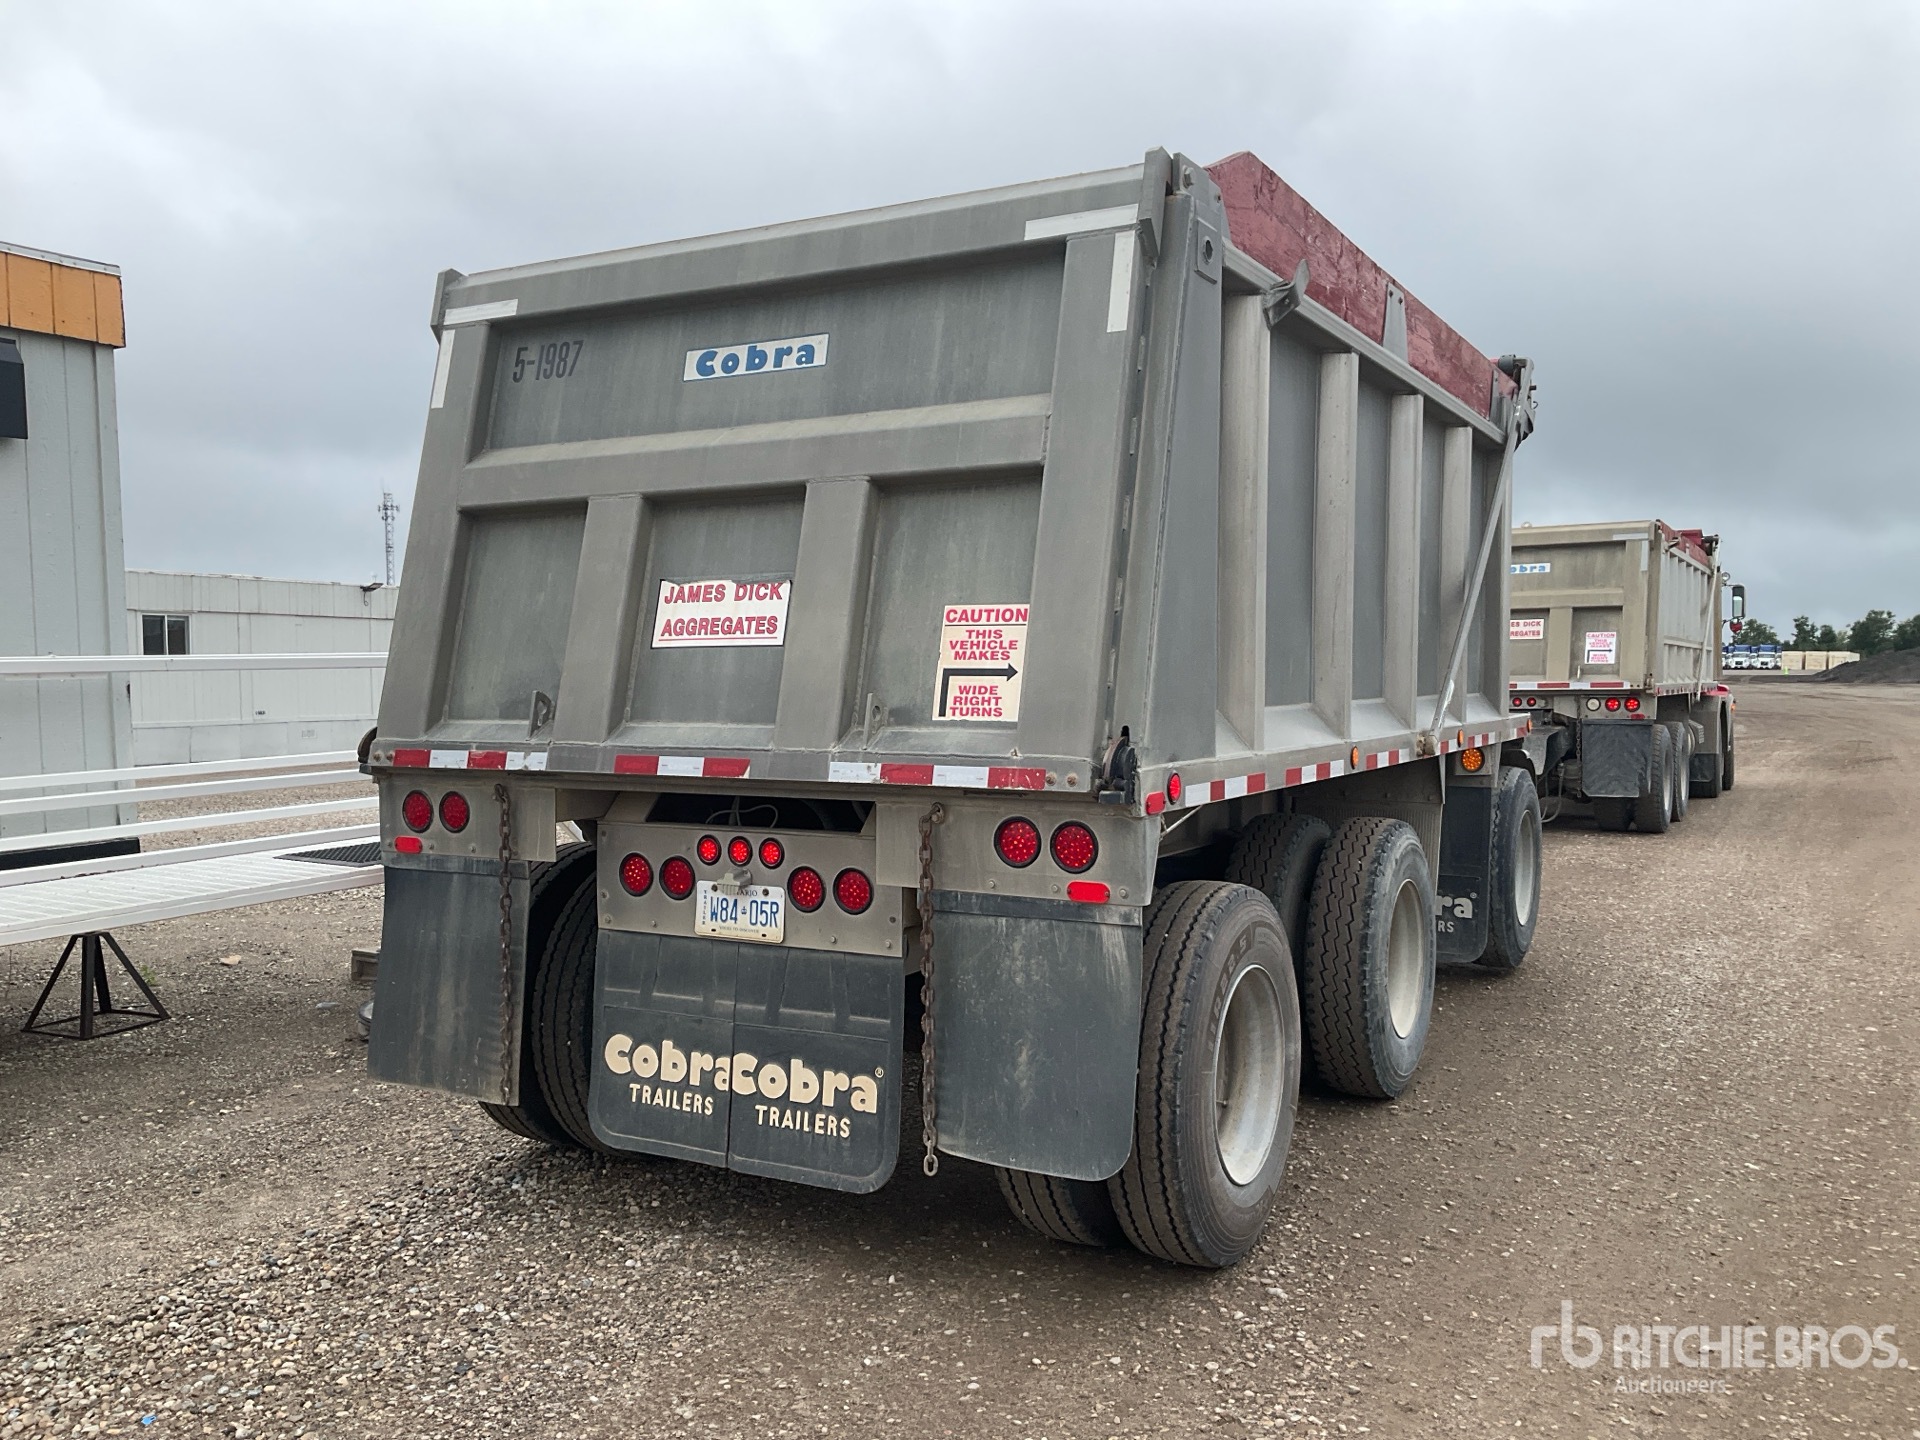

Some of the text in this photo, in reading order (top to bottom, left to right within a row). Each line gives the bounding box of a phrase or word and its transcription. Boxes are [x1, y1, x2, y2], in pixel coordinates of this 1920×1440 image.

[512, 340, 585, 383] 5-1987
[695, 343, 816, 377] Cobra
[1510, 565, 1546, 573] obra
[664, 582, 783, 605] JAMES DICK
[660, 615, 778, 637] AGGREGATES
[945, 608, 1029, 623] CAUTION
[949, 640, 1018, 650] VEHICLE
[965, 629, 1003, 640] THIS
[953, 650, 1011, 661] MAKES
[953, 696, 1002, 706] RIGHT
[958, 685, 999, 695] WIDE
[949, 707, 1003, 717] TURNS
[710, 896, 738, 924] W84
[604, 1033, 731, 1092] Cobra
[731, 1052, 879, 1114] Cobra
[629, 1083, 714, 1116] TRAILERS
[754, 1104, 851, 1139] TRAILERS
